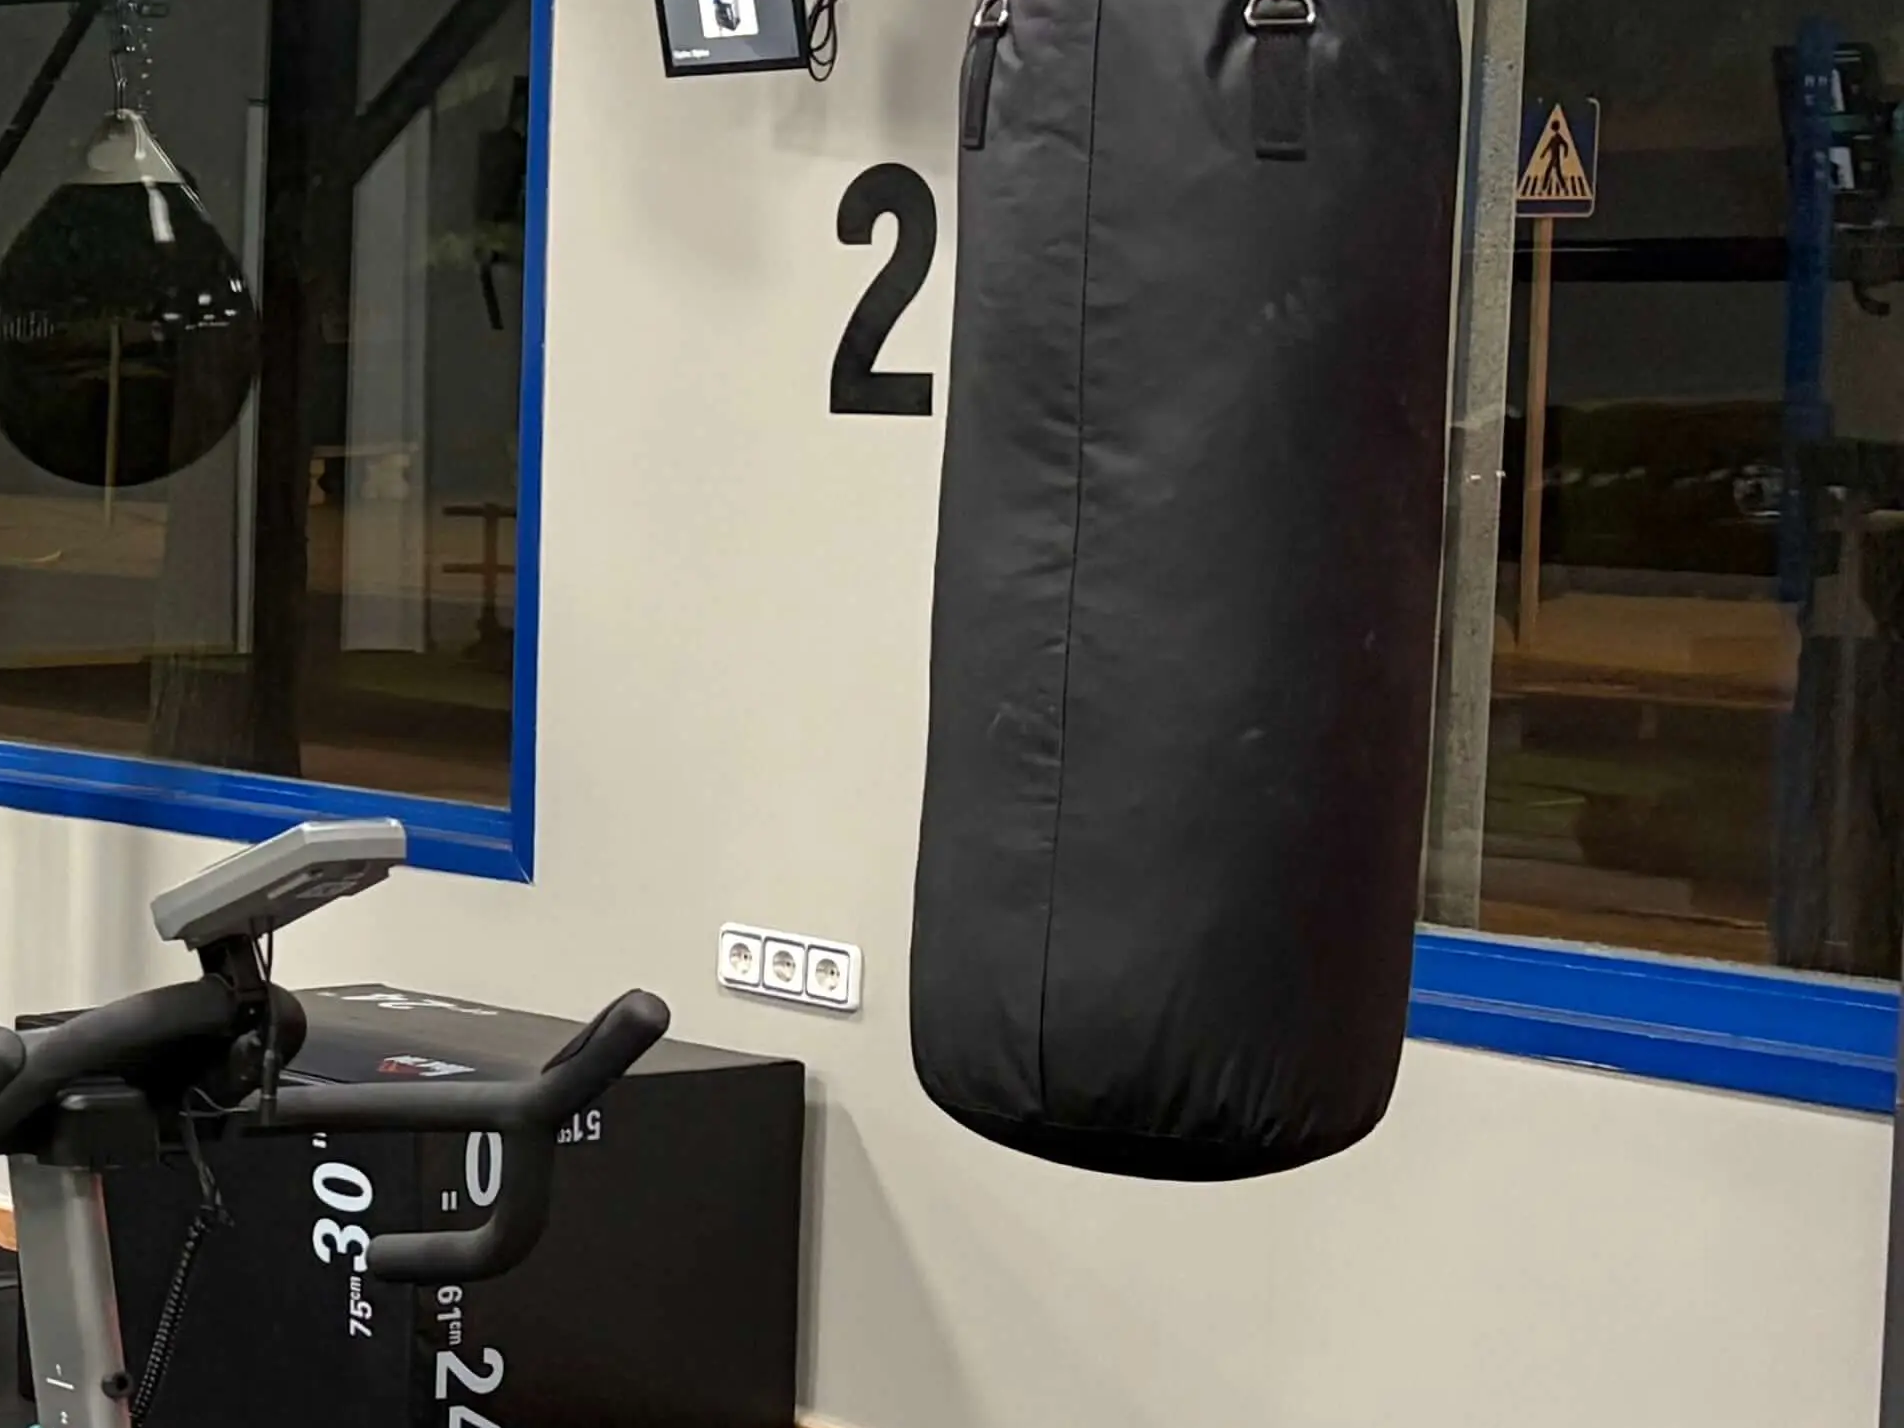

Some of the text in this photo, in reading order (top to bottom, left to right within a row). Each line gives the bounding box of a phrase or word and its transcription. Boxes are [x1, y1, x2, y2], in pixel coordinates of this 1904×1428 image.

[830, 162, 938, 417] 2
[349, 1275, 373, 1338] 75cm
[437, 1285, 464, 1346] 61cm
